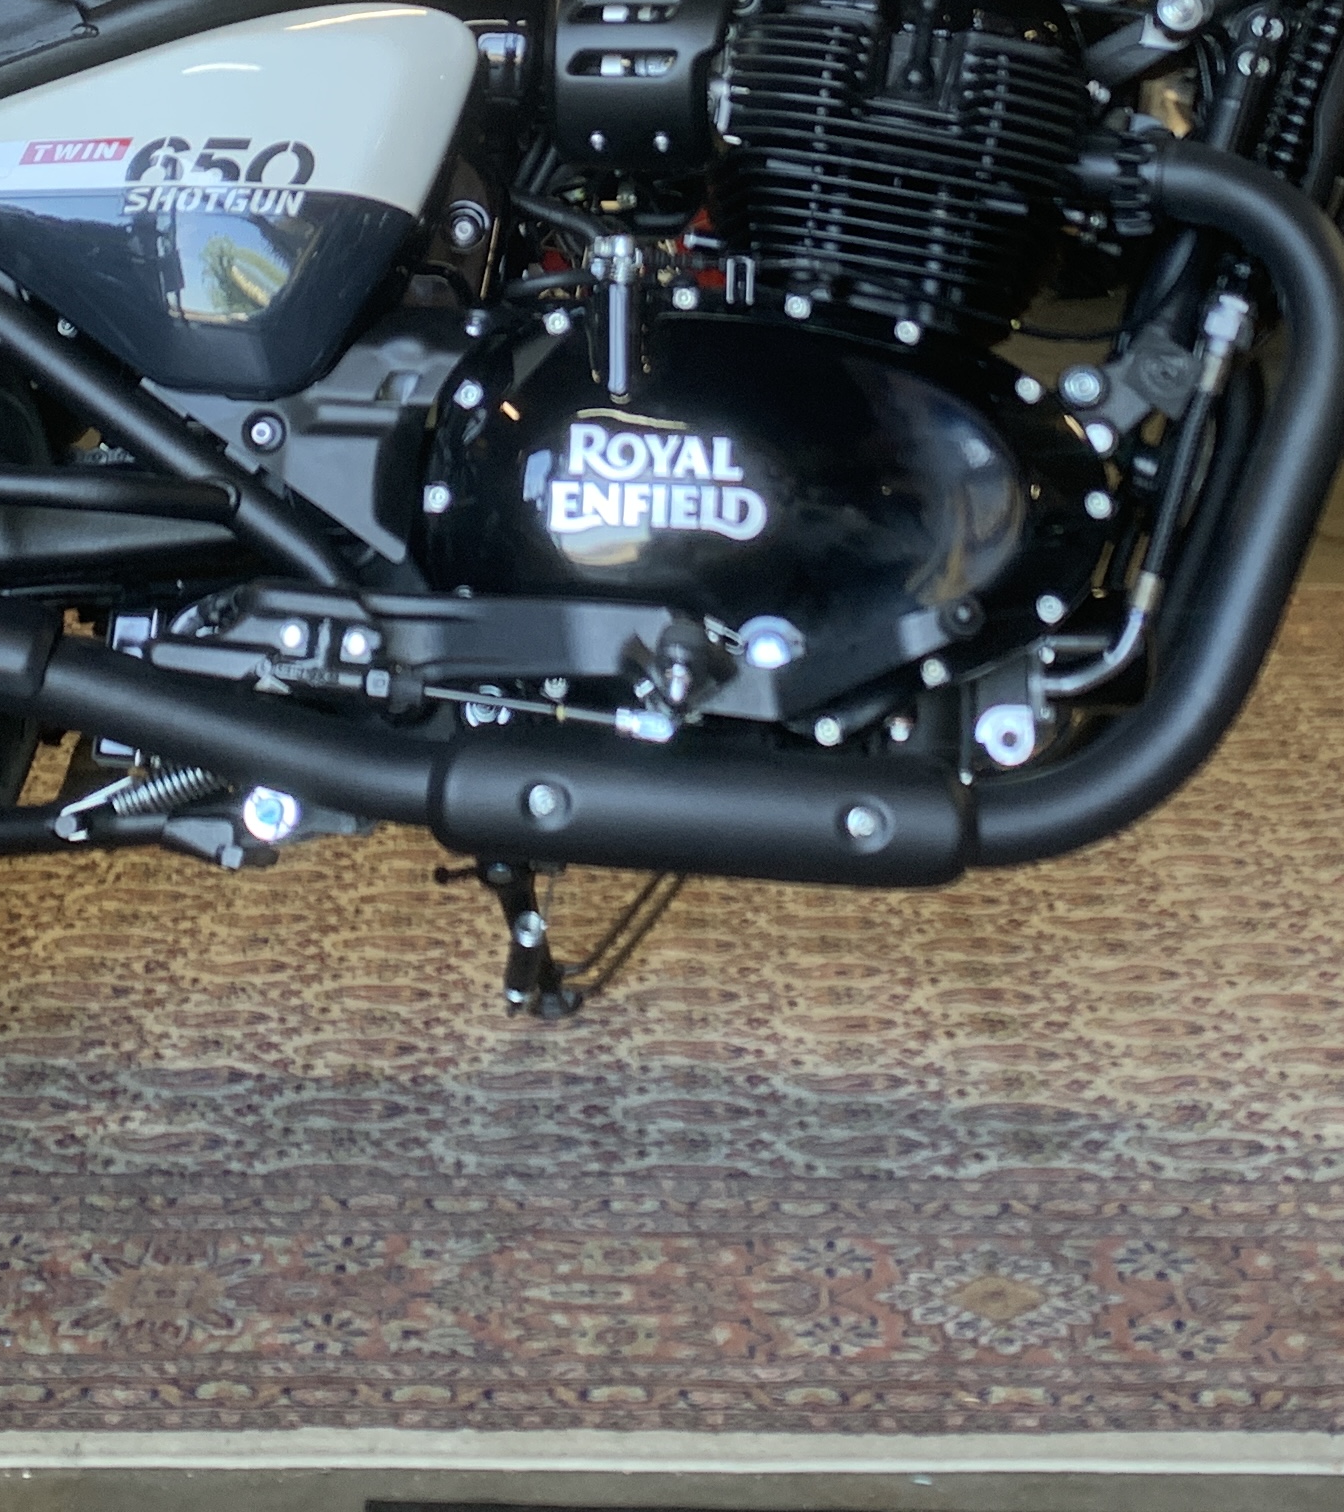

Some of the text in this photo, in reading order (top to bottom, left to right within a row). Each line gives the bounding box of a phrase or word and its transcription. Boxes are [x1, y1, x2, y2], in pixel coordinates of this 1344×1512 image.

[33, 141, 120, 164] TWIN
[124, 136, 316, 186] 650
[123, 187, 305, 218] SHOTGUN
[567, 422, 744, 482] ROYAL
[549, 480, 768, 541] ENFIELD
